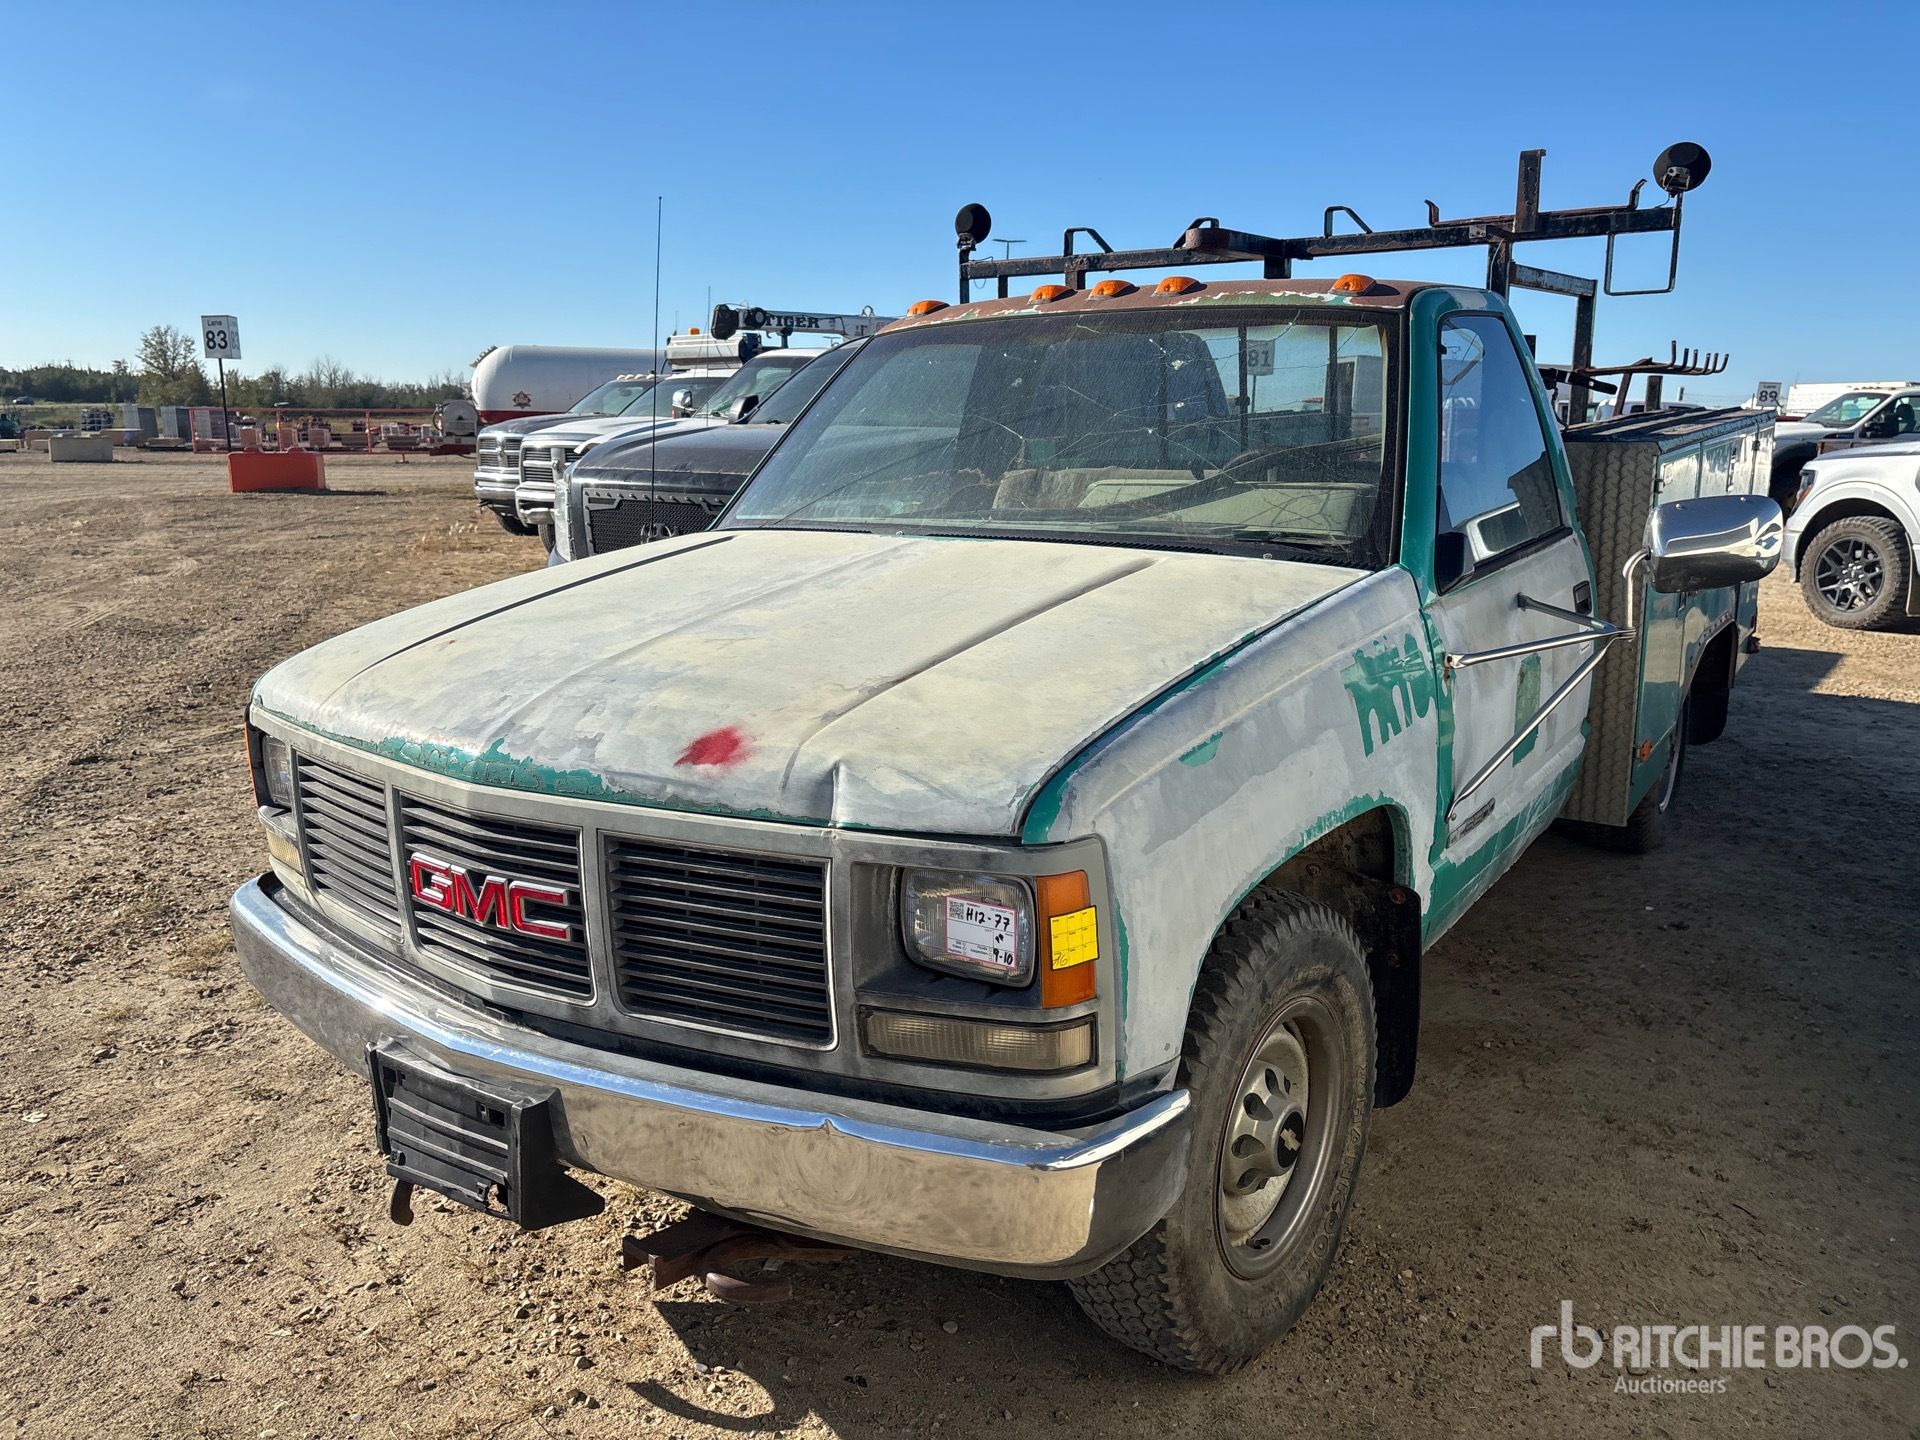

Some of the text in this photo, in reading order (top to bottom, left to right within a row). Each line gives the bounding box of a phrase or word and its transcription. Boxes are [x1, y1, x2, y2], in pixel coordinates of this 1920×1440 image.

[206, 319, 223, 327] Lane
[765, 315, 820, 328] TIGER
[205, 330, 228, 350] 83
[1247, 349, 1272, 367] 81
[1759, 390, 1778, 402] 89
[411, 851, 572, 942] GMC
[1299, 1098, 1369, 1284] HANKOOK
